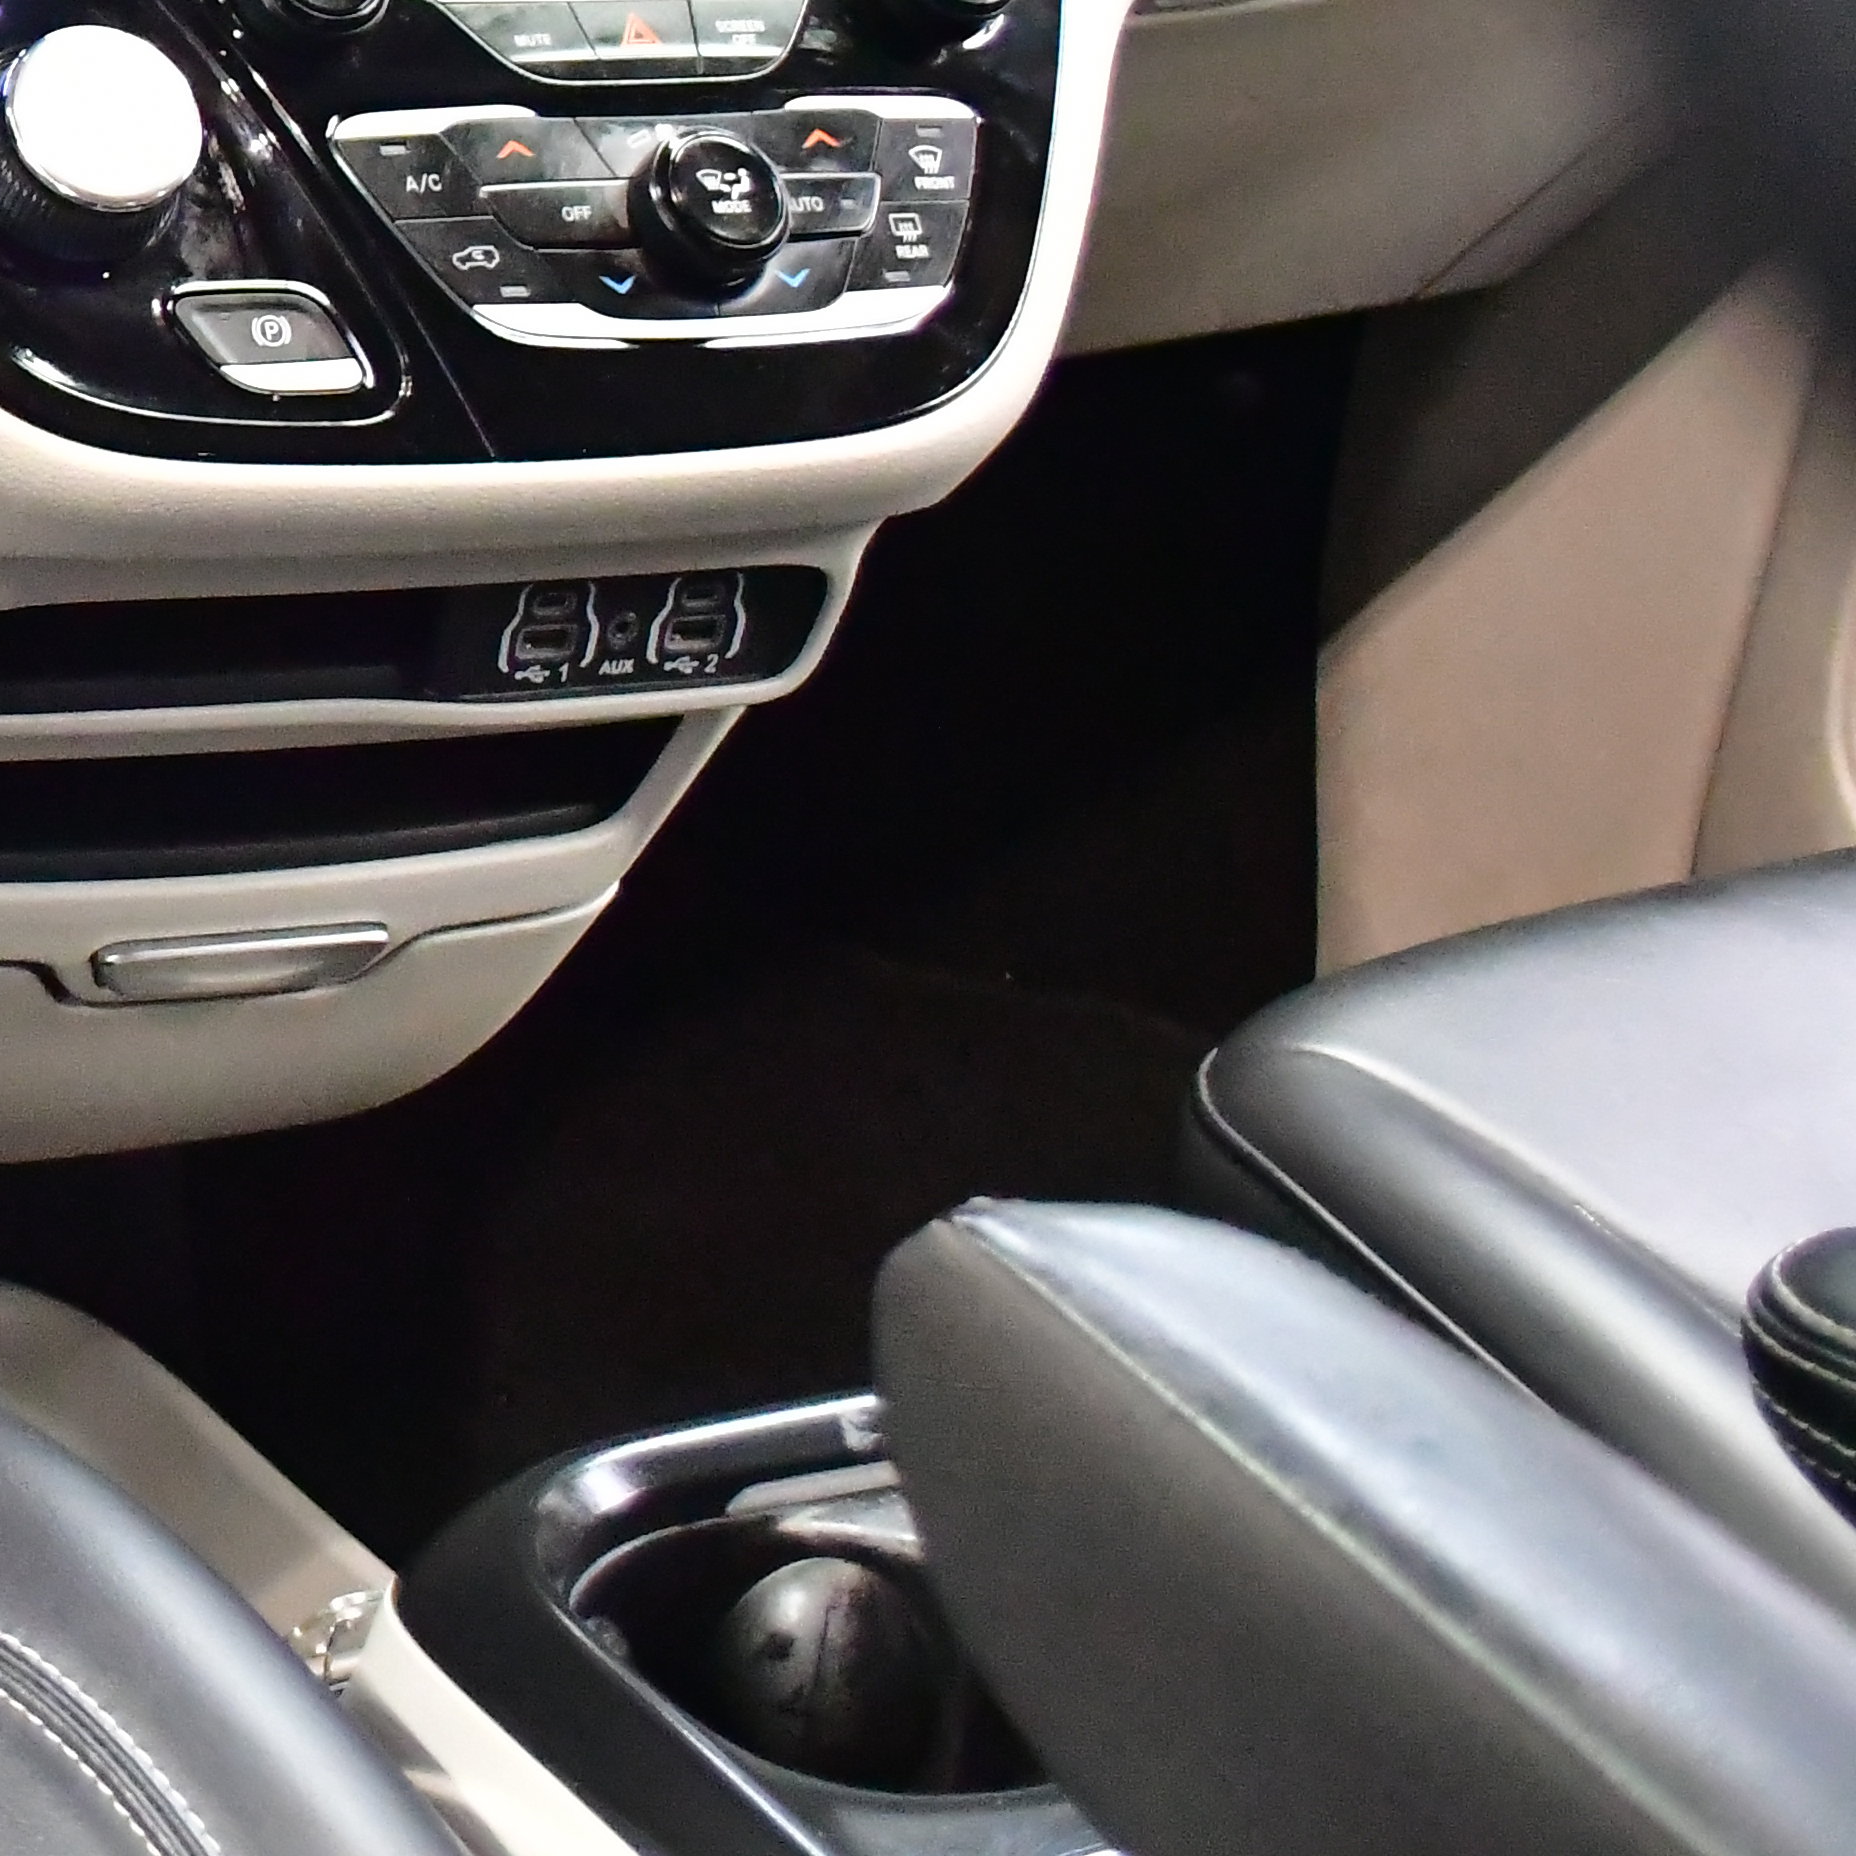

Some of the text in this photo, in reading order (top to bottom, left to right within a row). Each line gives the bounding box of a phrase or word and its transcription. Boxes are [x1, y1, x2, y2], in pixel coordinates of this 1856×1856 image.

[406, 173, 443, 194] A/C
[915, 176, 955, 190] FRONT
[561, 205, 592, 222] OFF
[712, 200, 752, 214] MODE
[896, 245, 929, 259] REAR
[599, 658, 634, 675] AUX
[704, 654, 719, 674] 2
